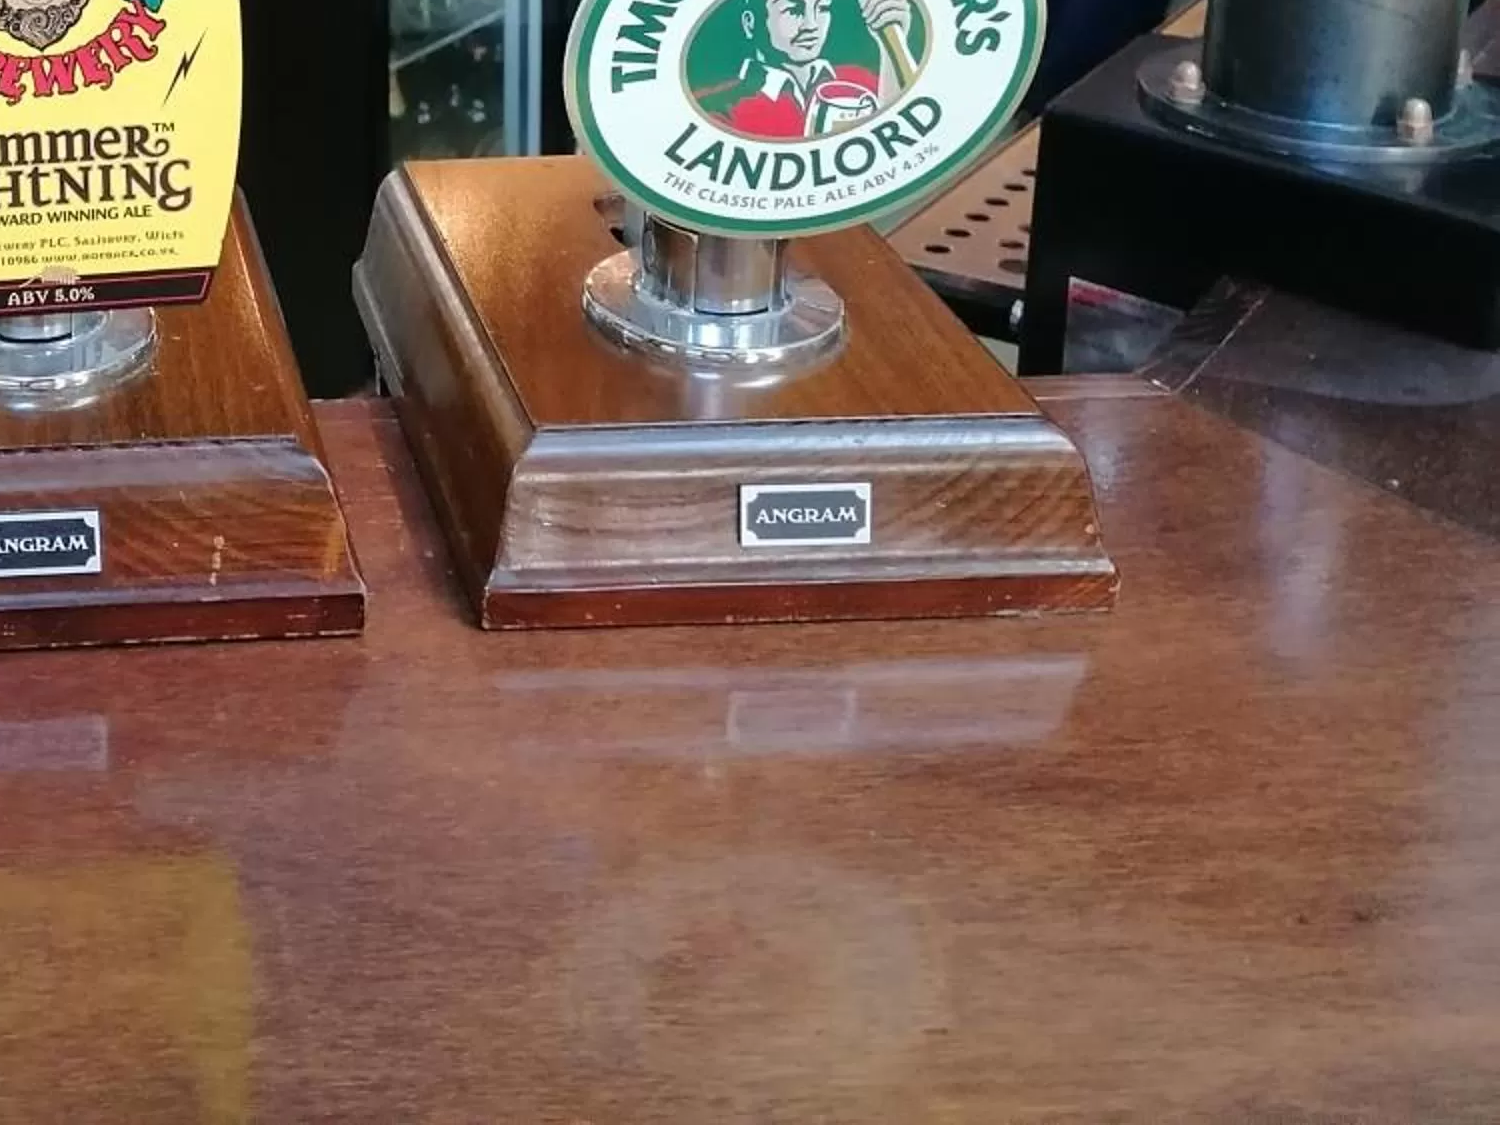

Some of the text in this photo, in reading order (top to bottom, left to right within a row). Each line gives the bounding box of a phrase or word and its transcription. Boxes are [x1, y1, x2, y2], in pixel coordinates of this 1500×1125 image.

[664, 96, 942, 191] LANDLORD
[663, 143, 941, 210] THE CLASSIC PALE ALE ABV 4.3%
[48, 207, 119, 224] WINNING
[123, 204, 152, 218] ALE
[7, 286, 96, 306] ABV 5.0%
[755, 506, 858, 525] ANGRAM
